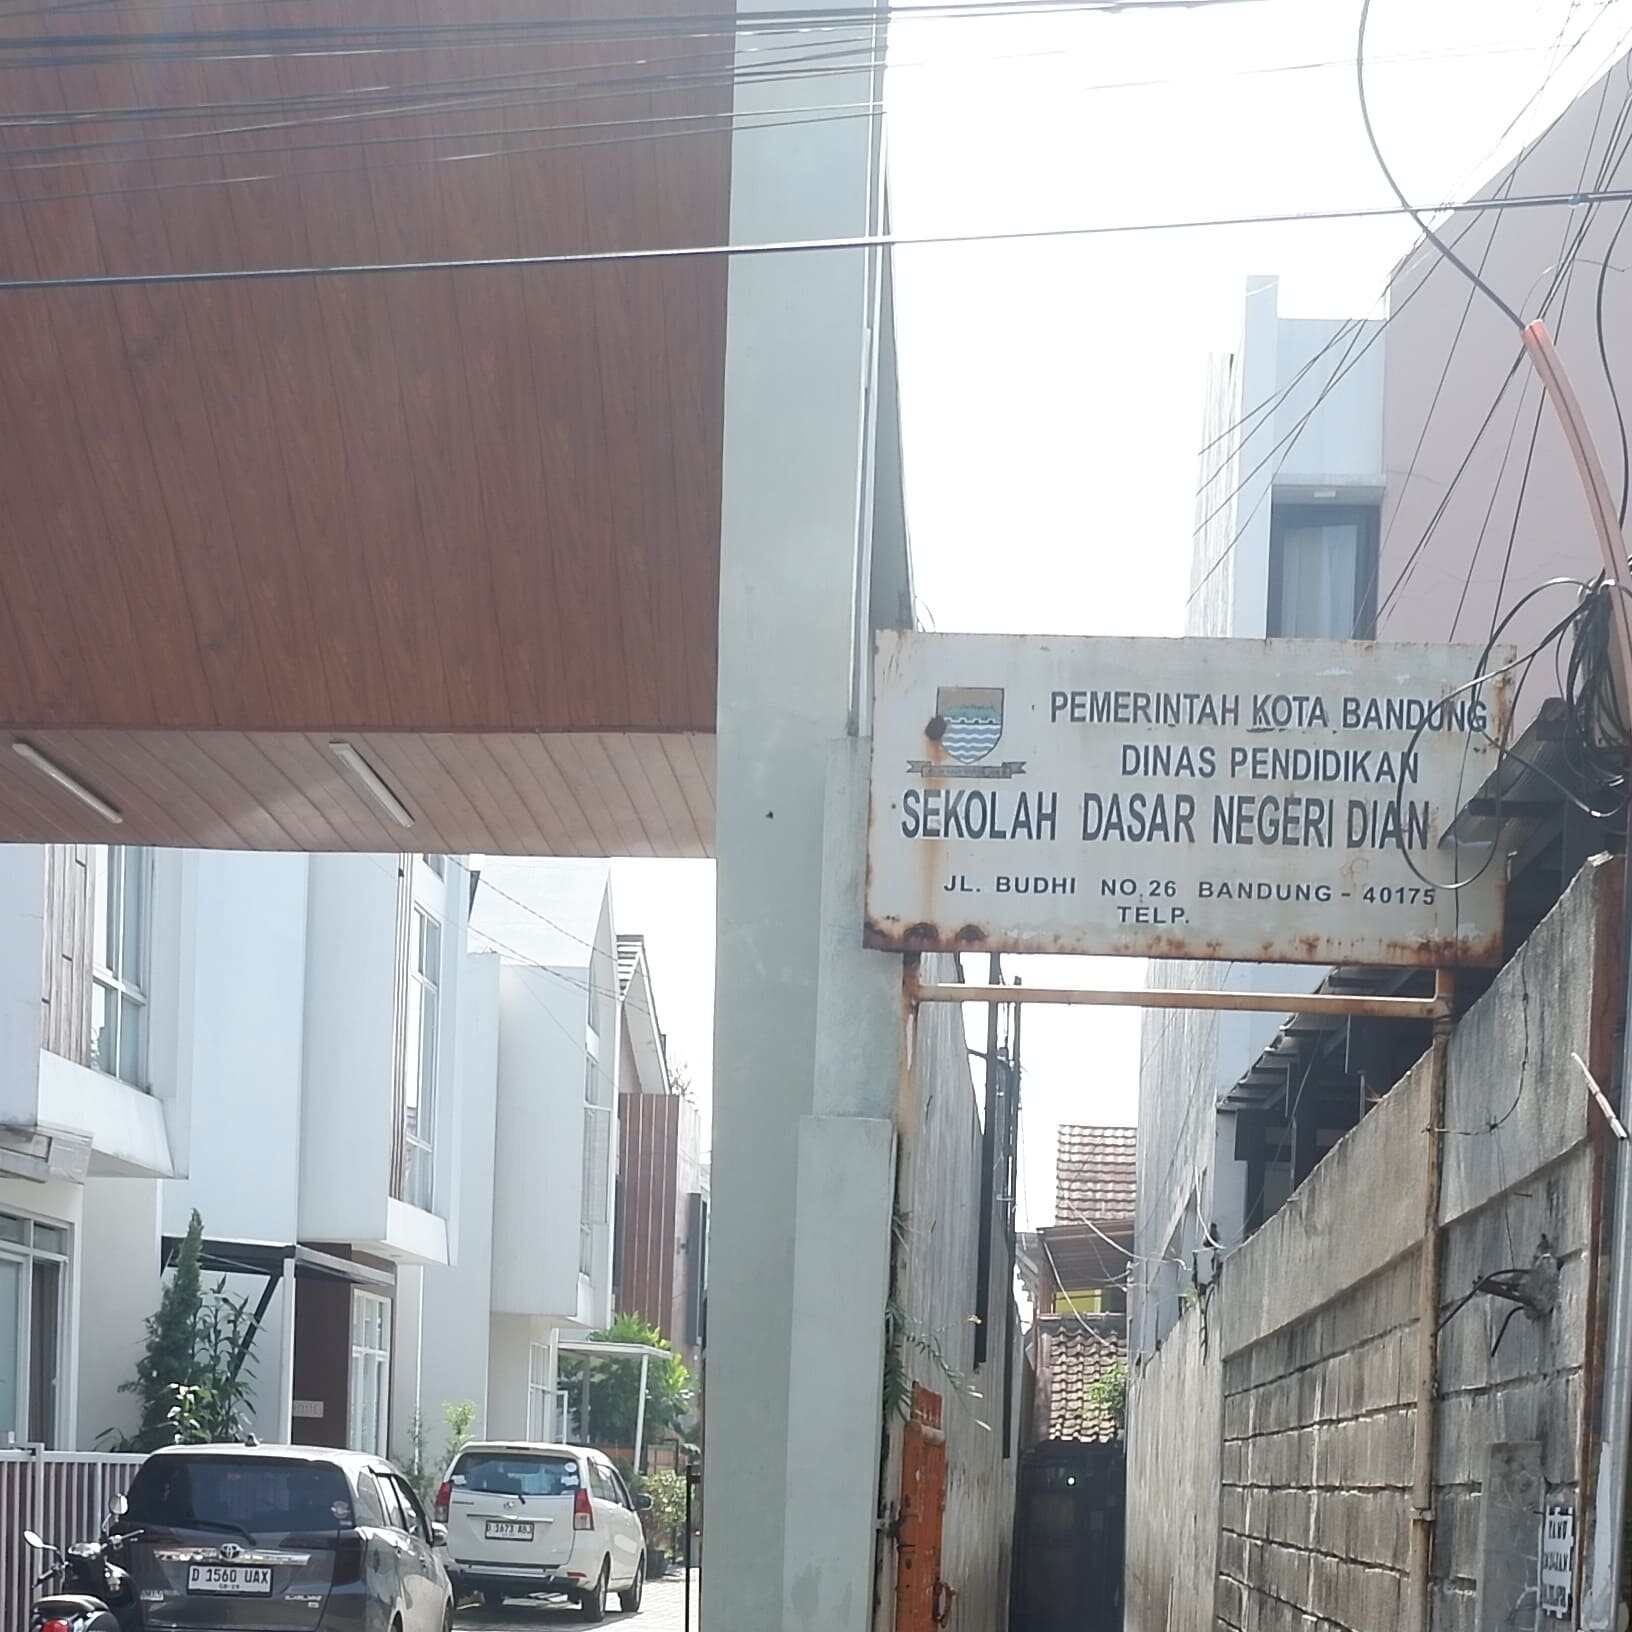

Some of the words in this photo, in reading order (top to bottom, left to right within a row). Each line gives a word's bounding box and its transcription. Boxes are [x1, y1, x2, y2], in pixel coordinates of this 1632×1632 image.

[1050, 691, 1239, 727] PEMERINTAH
[1252, 694, 1328, 729] KOTA
[1342, 697, 1487, 733] BANDUNG
[1121, 744, 1217, 778] DINAS
[1230, 746, 1419, 784] PENDIDIKAN
[901, 788, 1057, 842] SEKOLAH
[1082, 792, 1194, 844] DASAR
[1213, 795, 1331, 849] NEGERI
[1346, 799, 1429, 851] DIAN
[944, 875, 981, 894] JL.
[996, 875, 1076, 896] BUDHI
[1198, 881, 1332, 902] BANDUNG
[1363, 886, 1436, 906] 40175
[1117, 905, 1190, 924] TELP.
[191, 1568, 200, 1582] D
[206, 1569, 237, 1583] 1560
[244, 1570, 269, 1584] UAX
